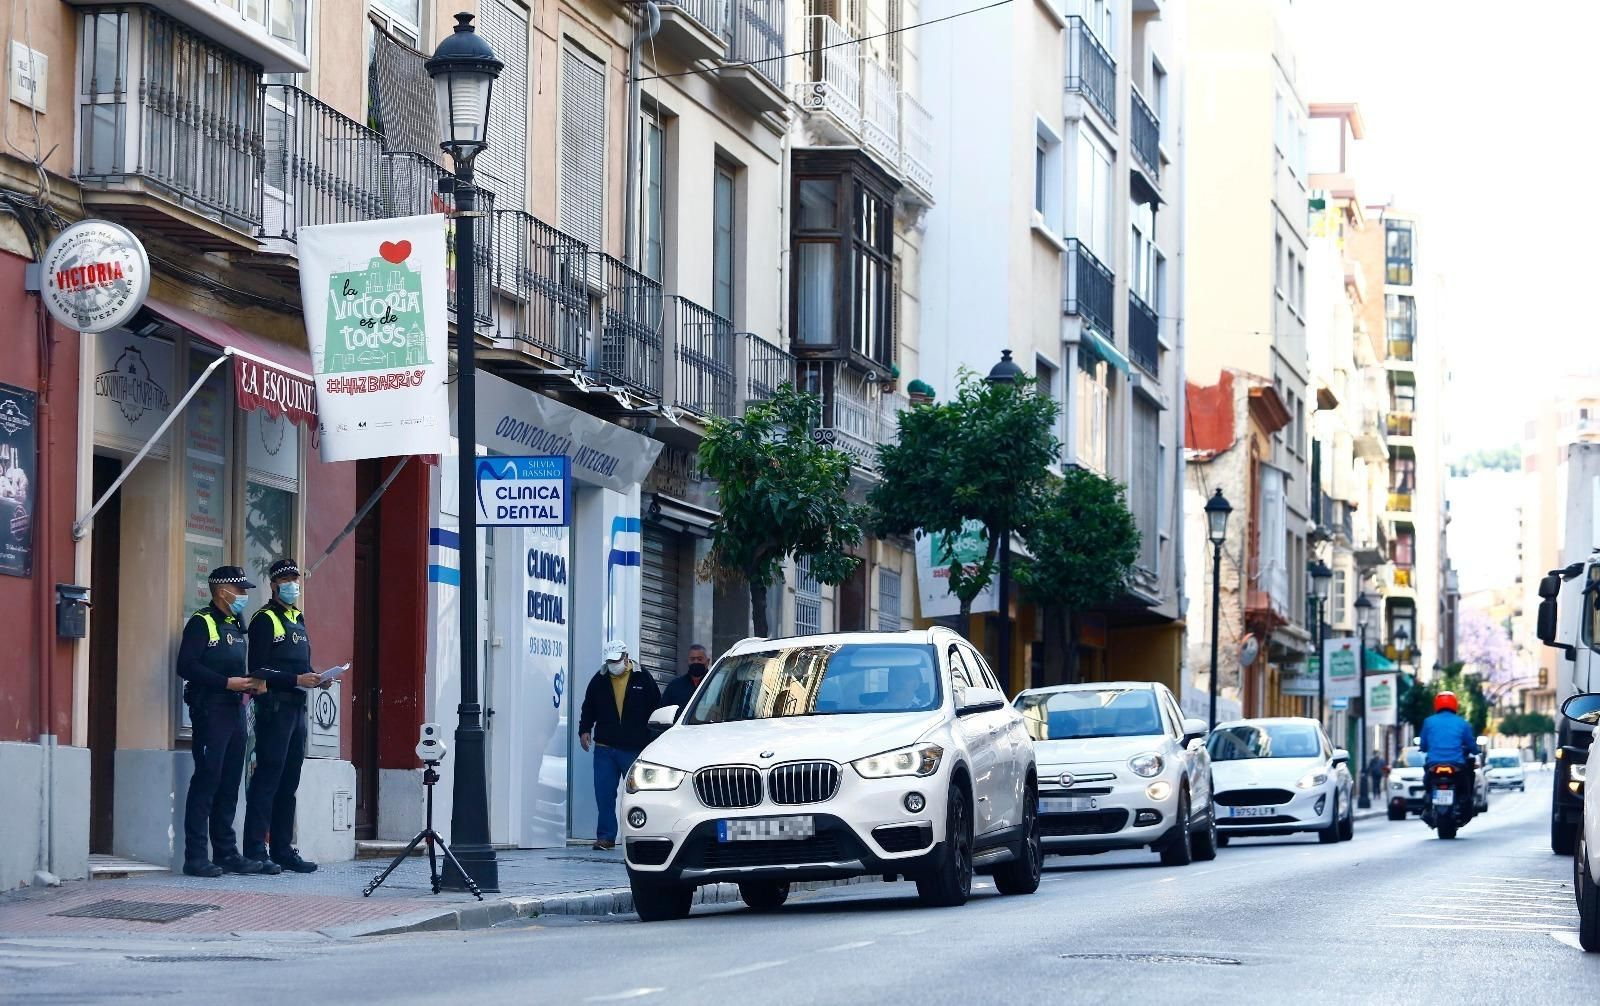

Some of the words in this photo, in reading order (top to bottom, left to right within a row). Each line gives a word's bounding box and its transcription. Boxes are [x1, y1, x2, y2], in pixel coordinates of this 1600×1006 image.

[56, 261, 124, 290] VICTORIA
[342, 279, 358, 296] la
[52, 293, 70, 314] BIER
[71, 307, 118, 321] CERVEZA
[117, 279, 133, 306] BEER
[359, 317, 376, 329] es
[380, 306, 398, 325] de
[339, 322, 406, 350] todos
[241, 361, 259, 396] LA
[262, 369, 319, 415] ESQUINIT
[528, 460, 555, 468] SILVIA
[572, 445, 620, 476] INTEGRAL
[496, 486, 560, 500] CLINICA
[497, 505, 558, 519] DENTAL
[527, 548, 567, 585] CLINICA
[527, 589, 566, 625] DENTAL
[529, 636, 540, 655] 951
[552, 641, 563, 658] 730
[1259, 807, 1275, 815] LF
